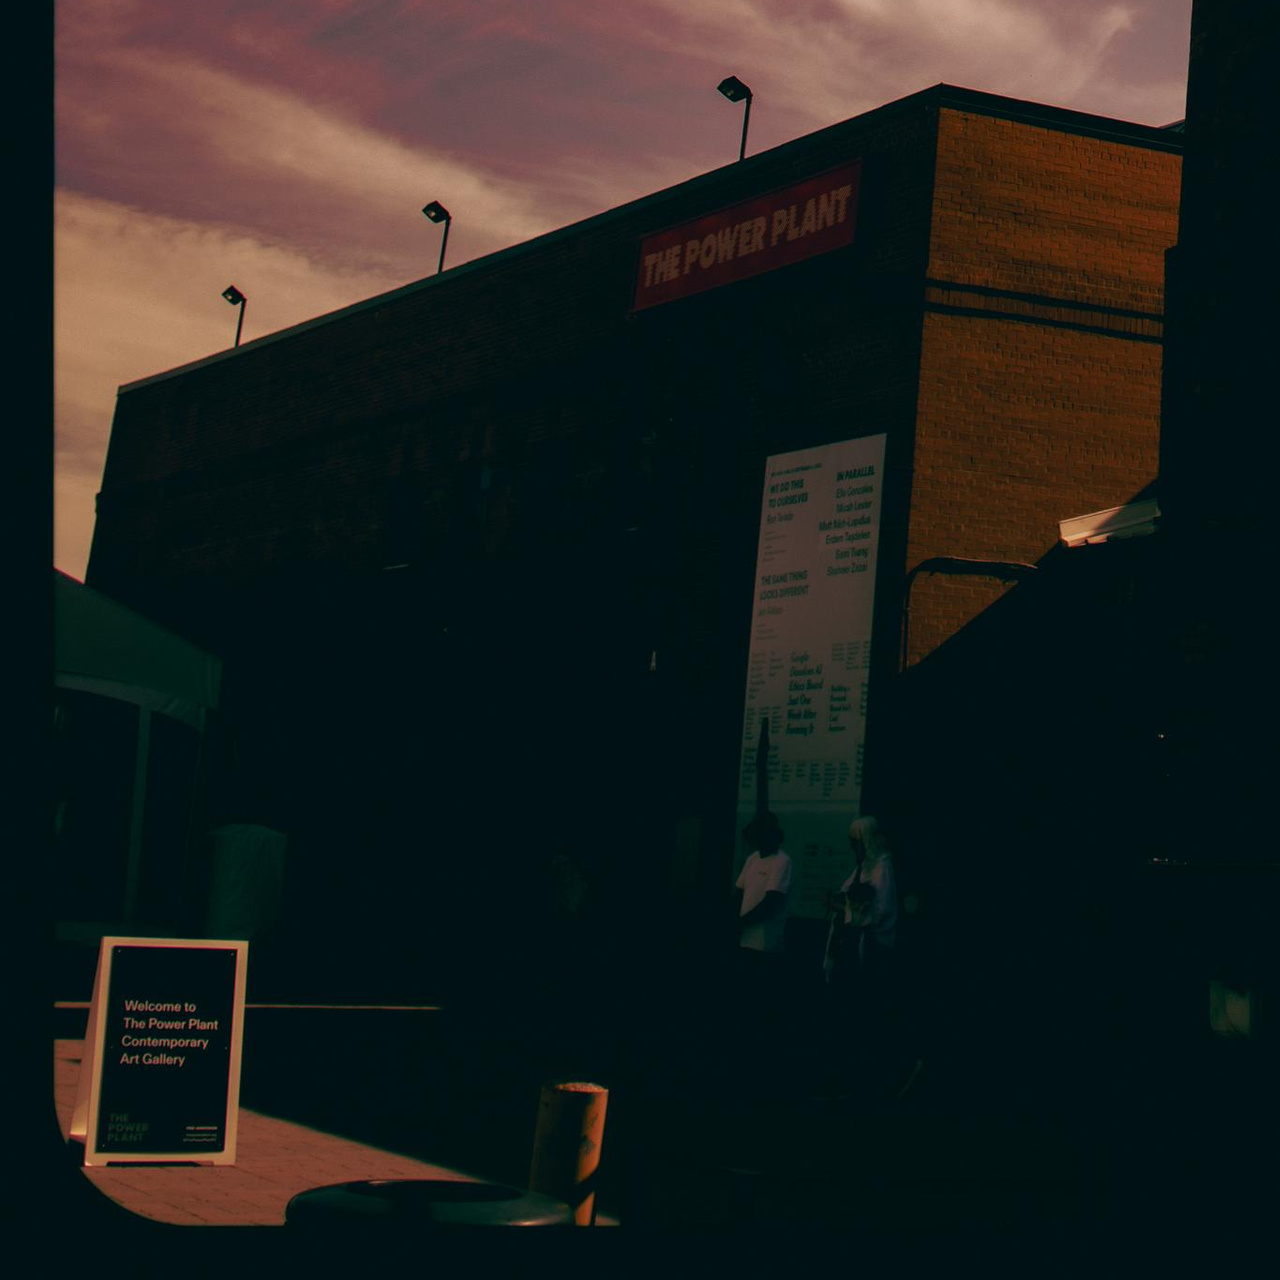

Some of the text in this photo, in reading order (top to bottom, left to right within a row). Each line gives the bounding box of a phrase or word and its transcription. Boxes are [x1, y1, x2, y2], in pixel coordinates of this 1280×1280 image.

[645, 184, 854, 288] THE POWER PLANT
[124, 1000, 197, 1013] Welcome to
[123, 1017, 219, 1031] The Power Plant
[121, 1035, 210, 1050] Contemporary
[119, 1052, 186, 1068] Art Gallery
[109, 1113, 129, 1123] THE
[107, 1123, 149, 1132] POWER
[107, 1133, 145, 1142] PLANT
